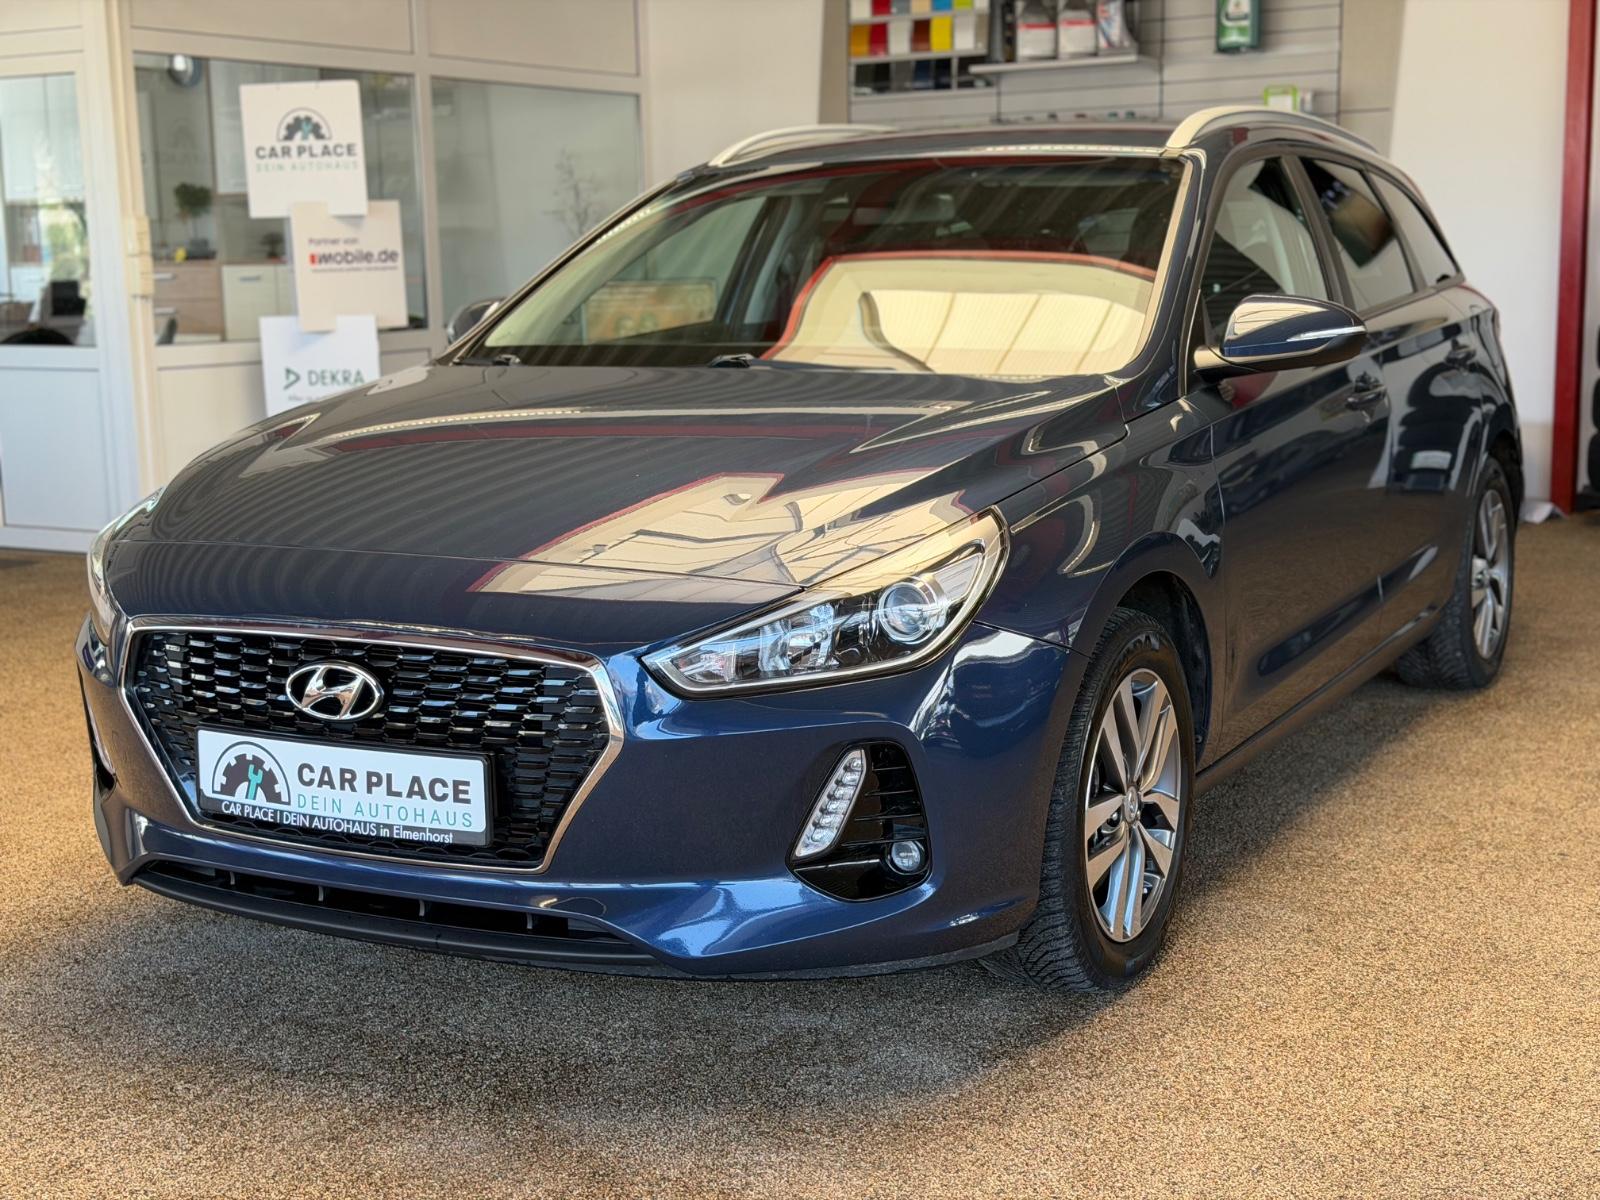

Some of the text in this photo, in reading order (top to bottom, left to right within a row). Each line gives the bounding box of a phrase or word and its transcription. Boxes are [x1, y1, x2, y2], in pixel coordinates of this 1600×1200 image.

[255, 143, 358, 159] CAR PLACE
[318, 249, 399, 265] mobile.de
[307, 369, 365, 387] DEKRA
[297, 763, 472, 805] CAR PLACE
[221, 800, 242, 817] CAR
[244, 804, 275, 823] PLACE
[283, 811, 310, 828] DEIN
[312, 817, 377, 836] AUTOHAUS
[380, 824, 390, 838] in
[393, 826, 454, 844] Elmenhorst
[297, 793, 473, 828] DEIN AUTOHAUS
